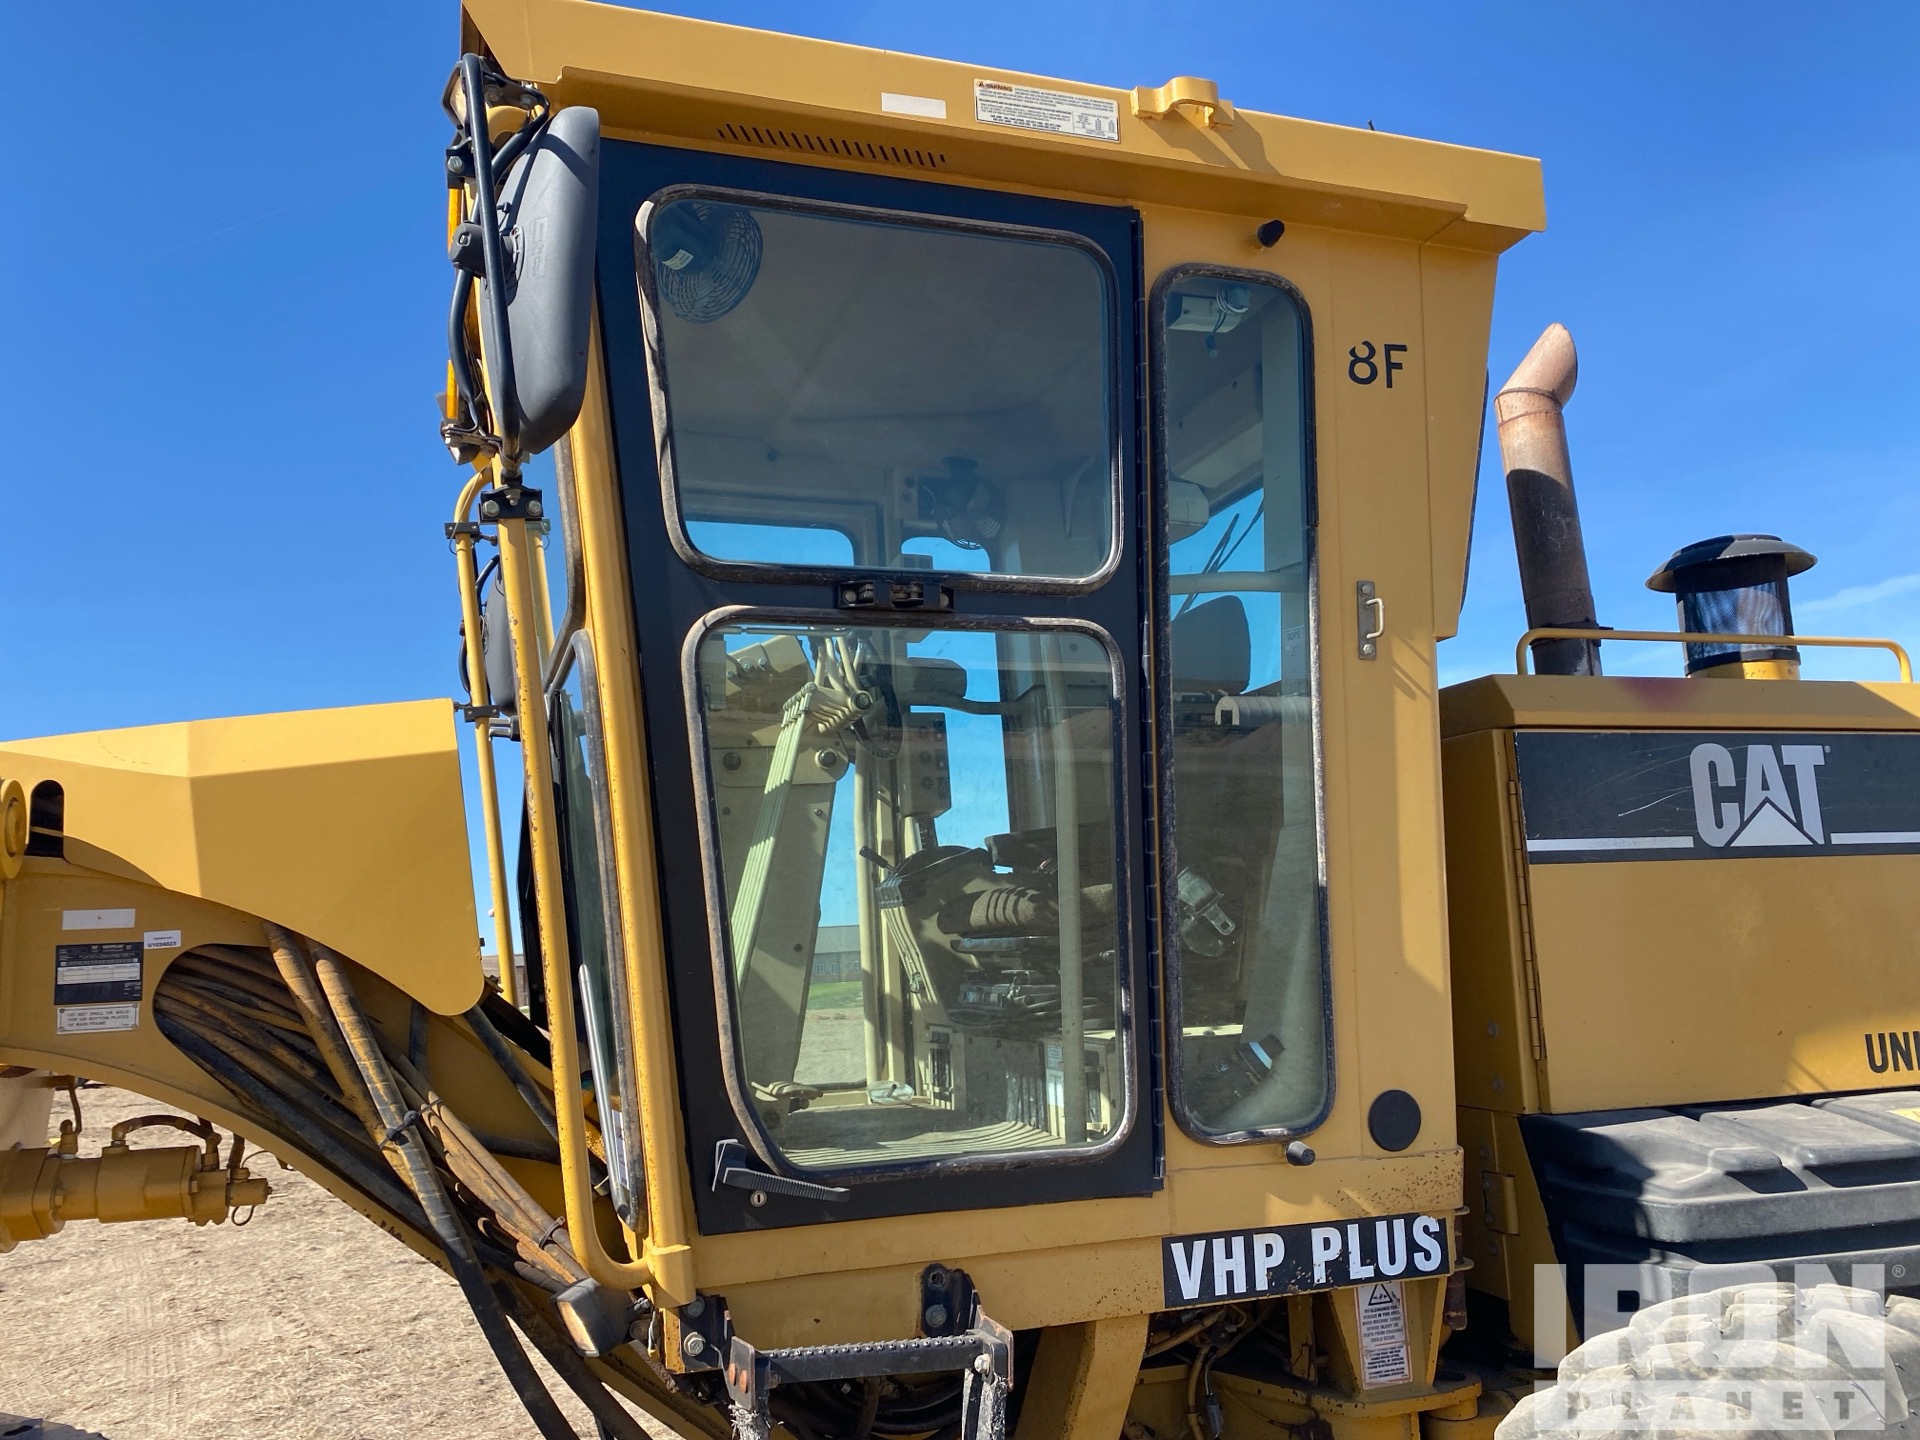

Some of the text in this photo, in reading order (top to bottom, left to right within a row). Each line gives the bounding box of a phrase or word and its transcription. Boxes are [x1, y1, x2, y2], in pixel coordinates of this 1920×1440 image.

[1348, 340, 1408, 389] 8F
[1689, 743, 1825, 848] CAT
[1170, 1215, 1442, 1300] VHP PLUS
